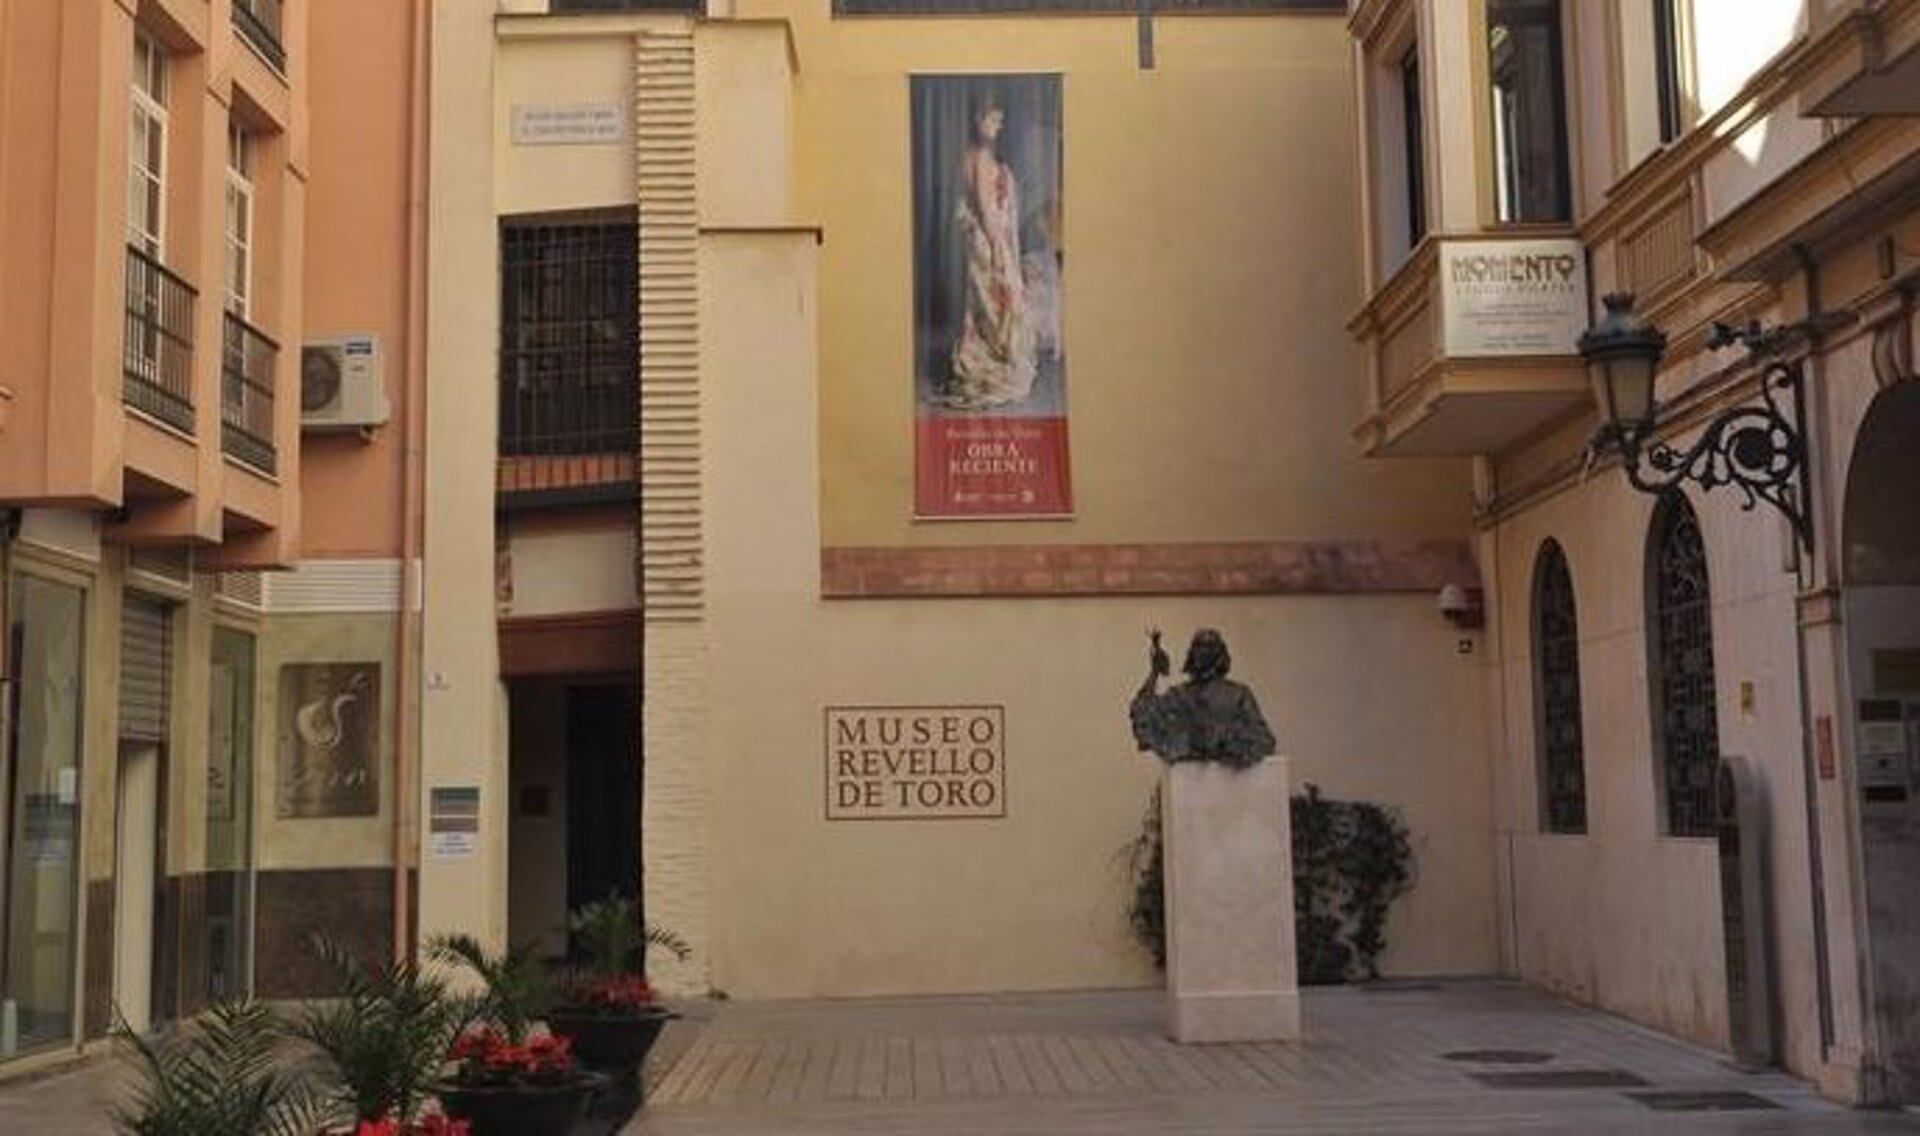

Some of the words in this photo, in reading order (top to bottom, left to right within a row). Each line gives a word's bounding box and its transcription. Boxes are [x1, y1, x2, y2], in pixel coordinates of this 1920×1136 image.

[1450, 254, 1575, 282] MOMENTO
[967, 442, 1019, 459] OBRA
[949, 459, 1037, 475] RECIENTE
[837, 716, 994, 745] MUSEO
[837, 748, 995, 776] REVELLO
[838, 780, 883, 808] DE
[893, 779, 995, 808] TORO
